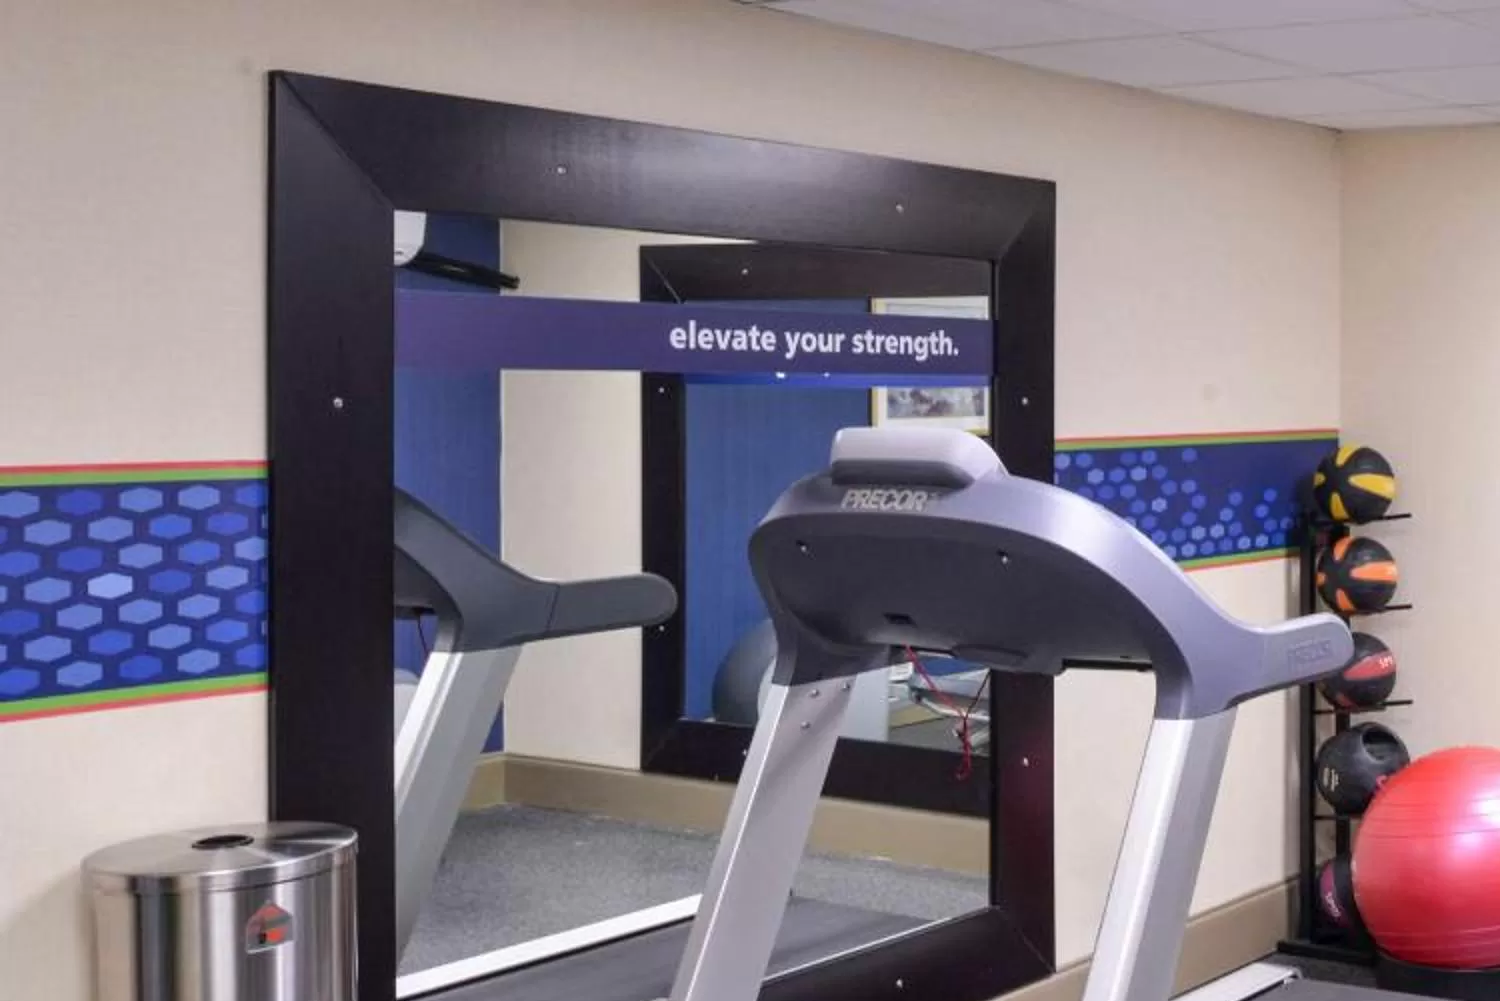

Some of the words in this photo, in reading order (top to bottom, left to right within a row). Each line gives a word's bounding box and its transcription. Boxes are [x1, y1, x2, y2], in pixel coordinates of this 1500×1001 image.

[669, 319, 777, 351] elevate
[783, 331, 845, 360] your
[852, 329, 959, 361] strength.
[841, 487, 929, 511] PRECOR
